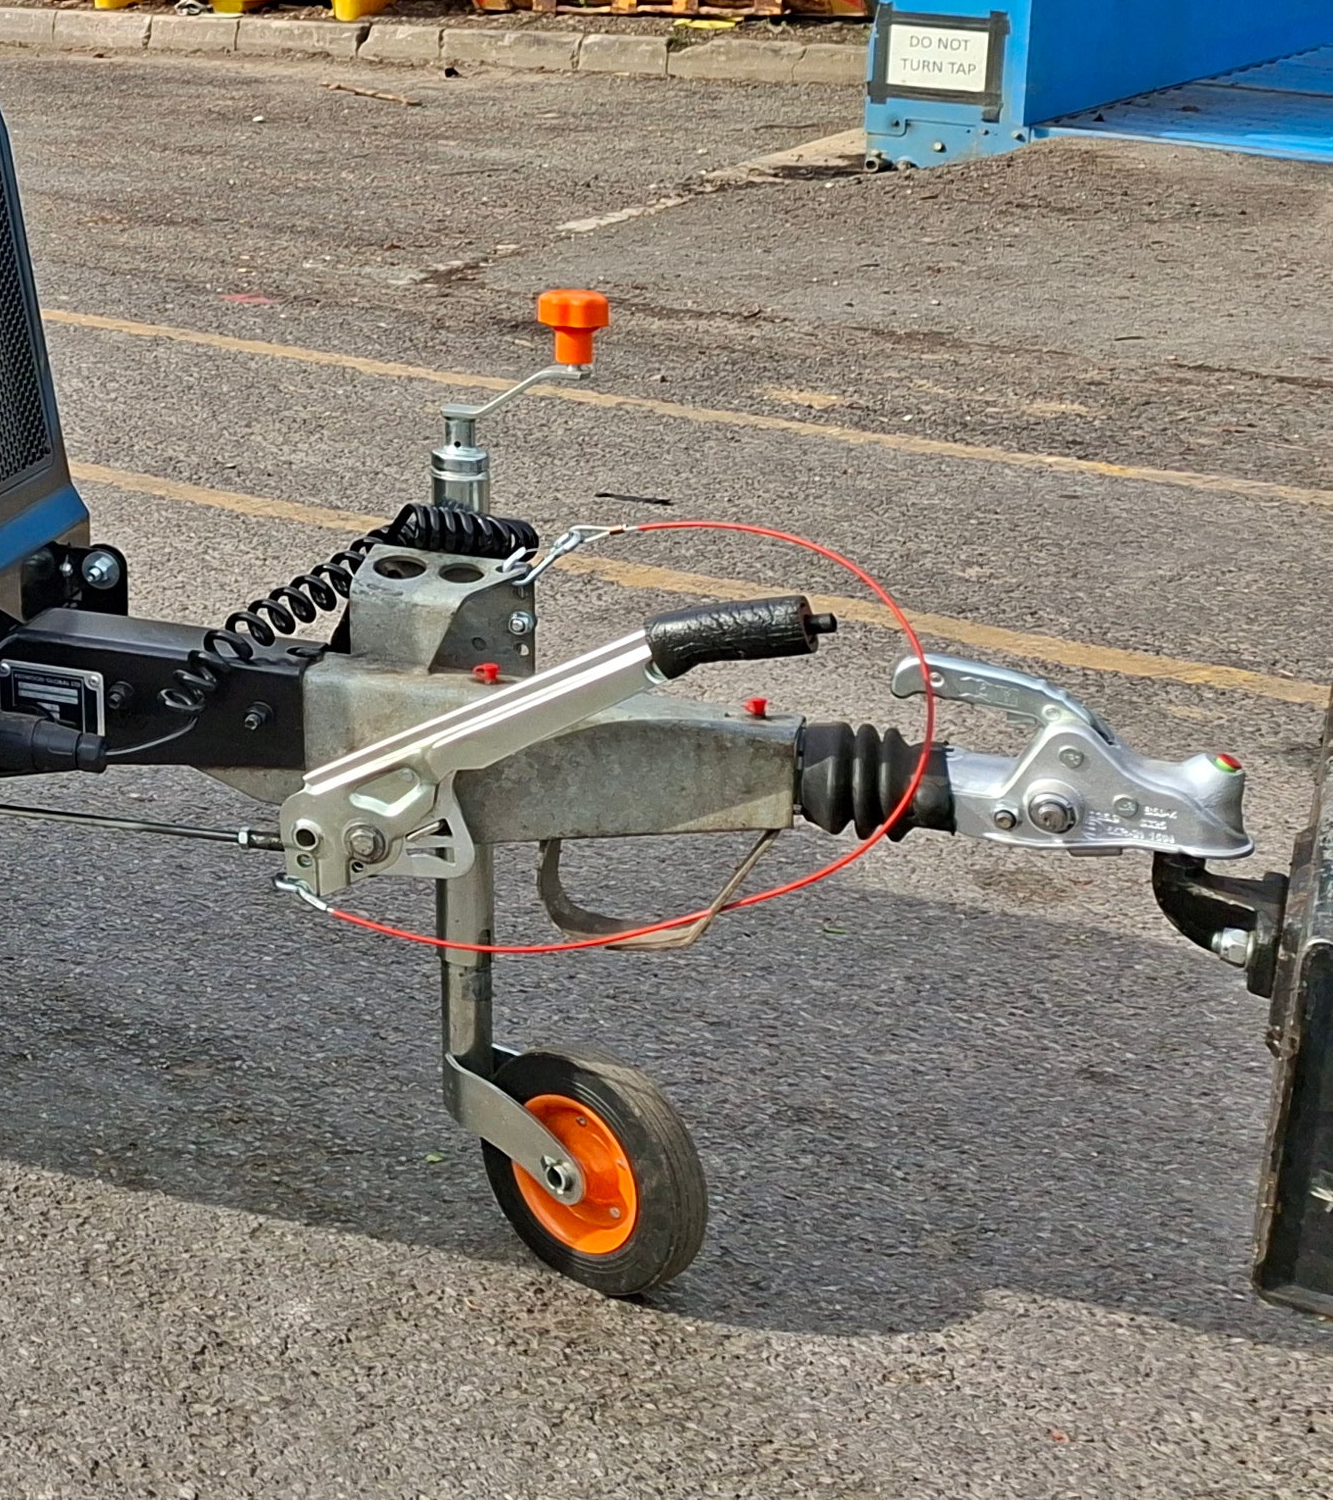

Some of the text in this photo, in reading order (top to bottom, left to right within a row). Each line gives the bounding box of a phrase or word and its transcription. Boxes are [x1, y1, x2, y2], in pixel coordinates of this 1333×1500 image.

[909, 35, 971, 51] DO NOT
[901, 58, 977, 76] TURN TAP
